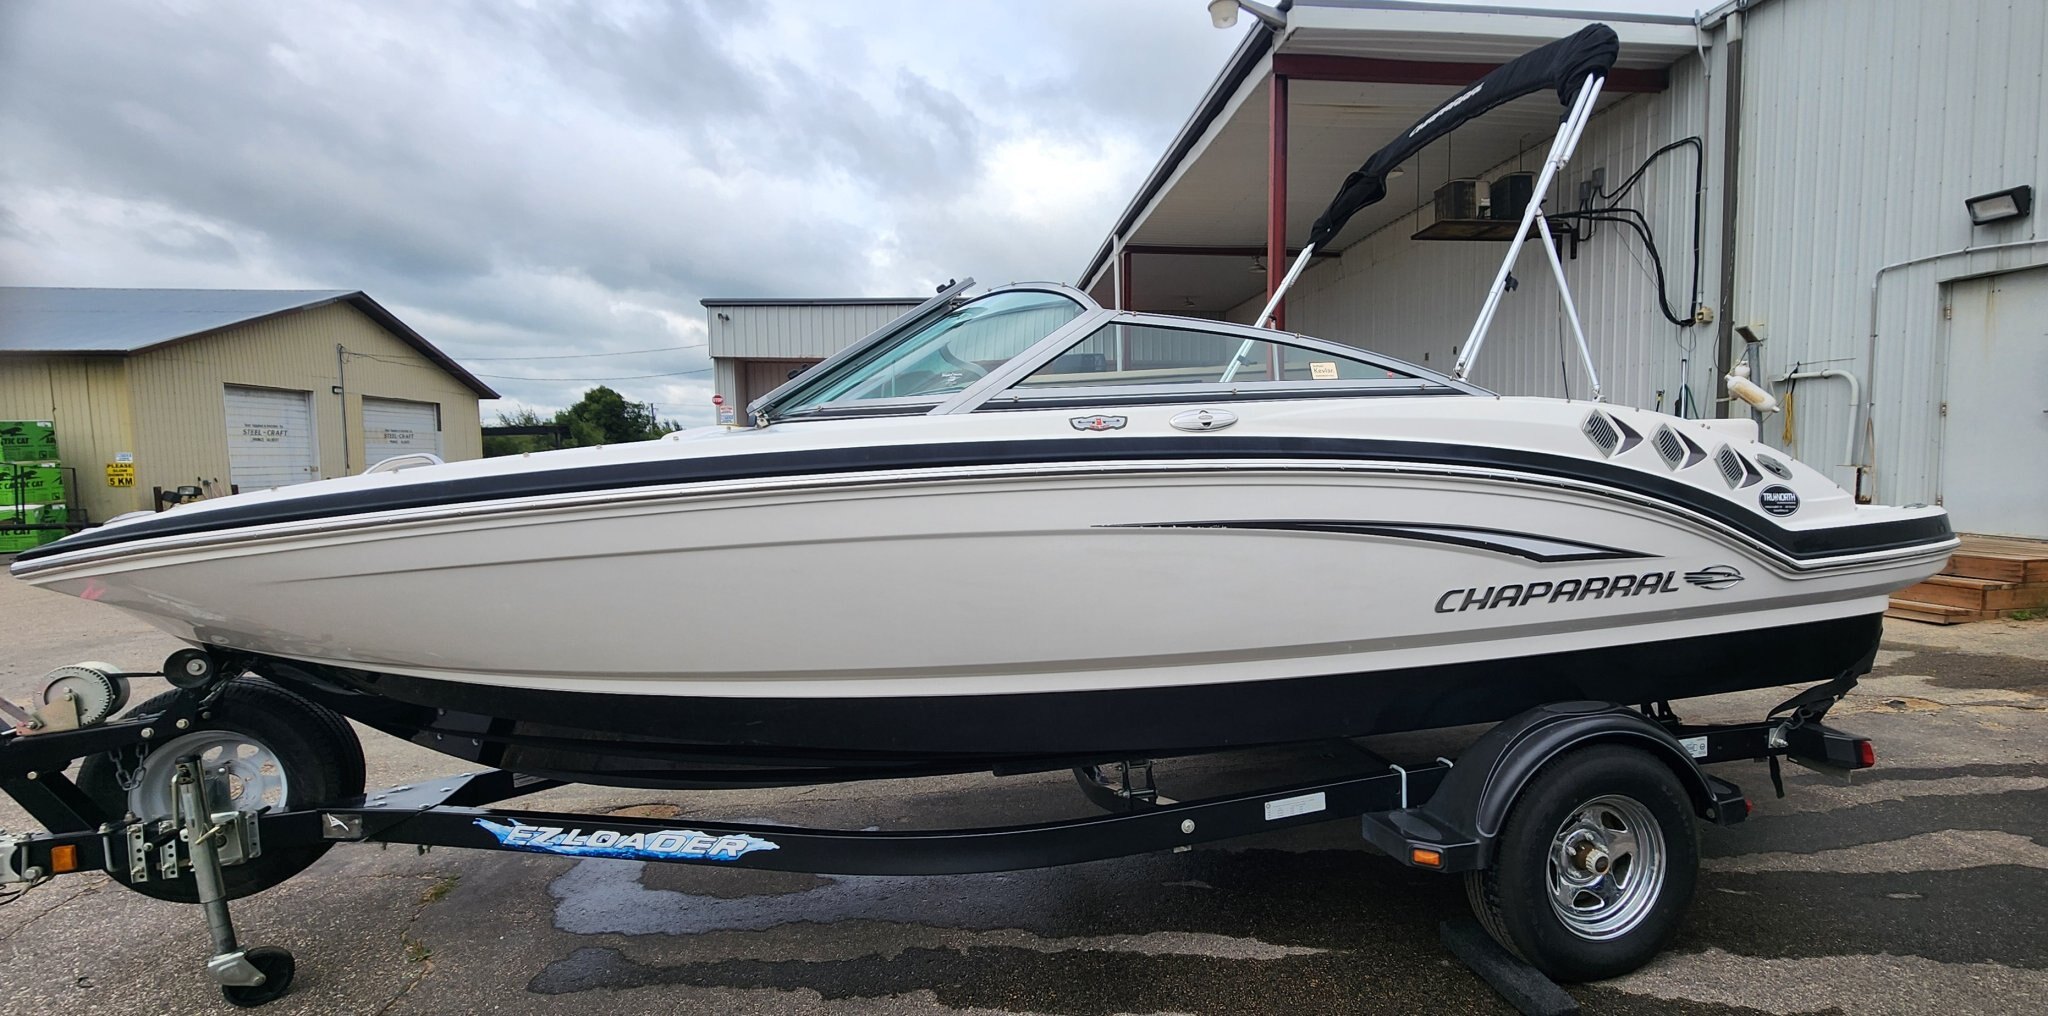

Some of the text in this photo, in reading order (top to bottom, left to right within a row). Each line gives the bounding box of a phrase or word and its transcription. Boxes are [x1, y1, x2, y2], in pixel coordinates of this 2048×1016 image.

[110, 477, 133, 486] 5 KM
[1434, 570, 1679, 614] CHAPARRAL
